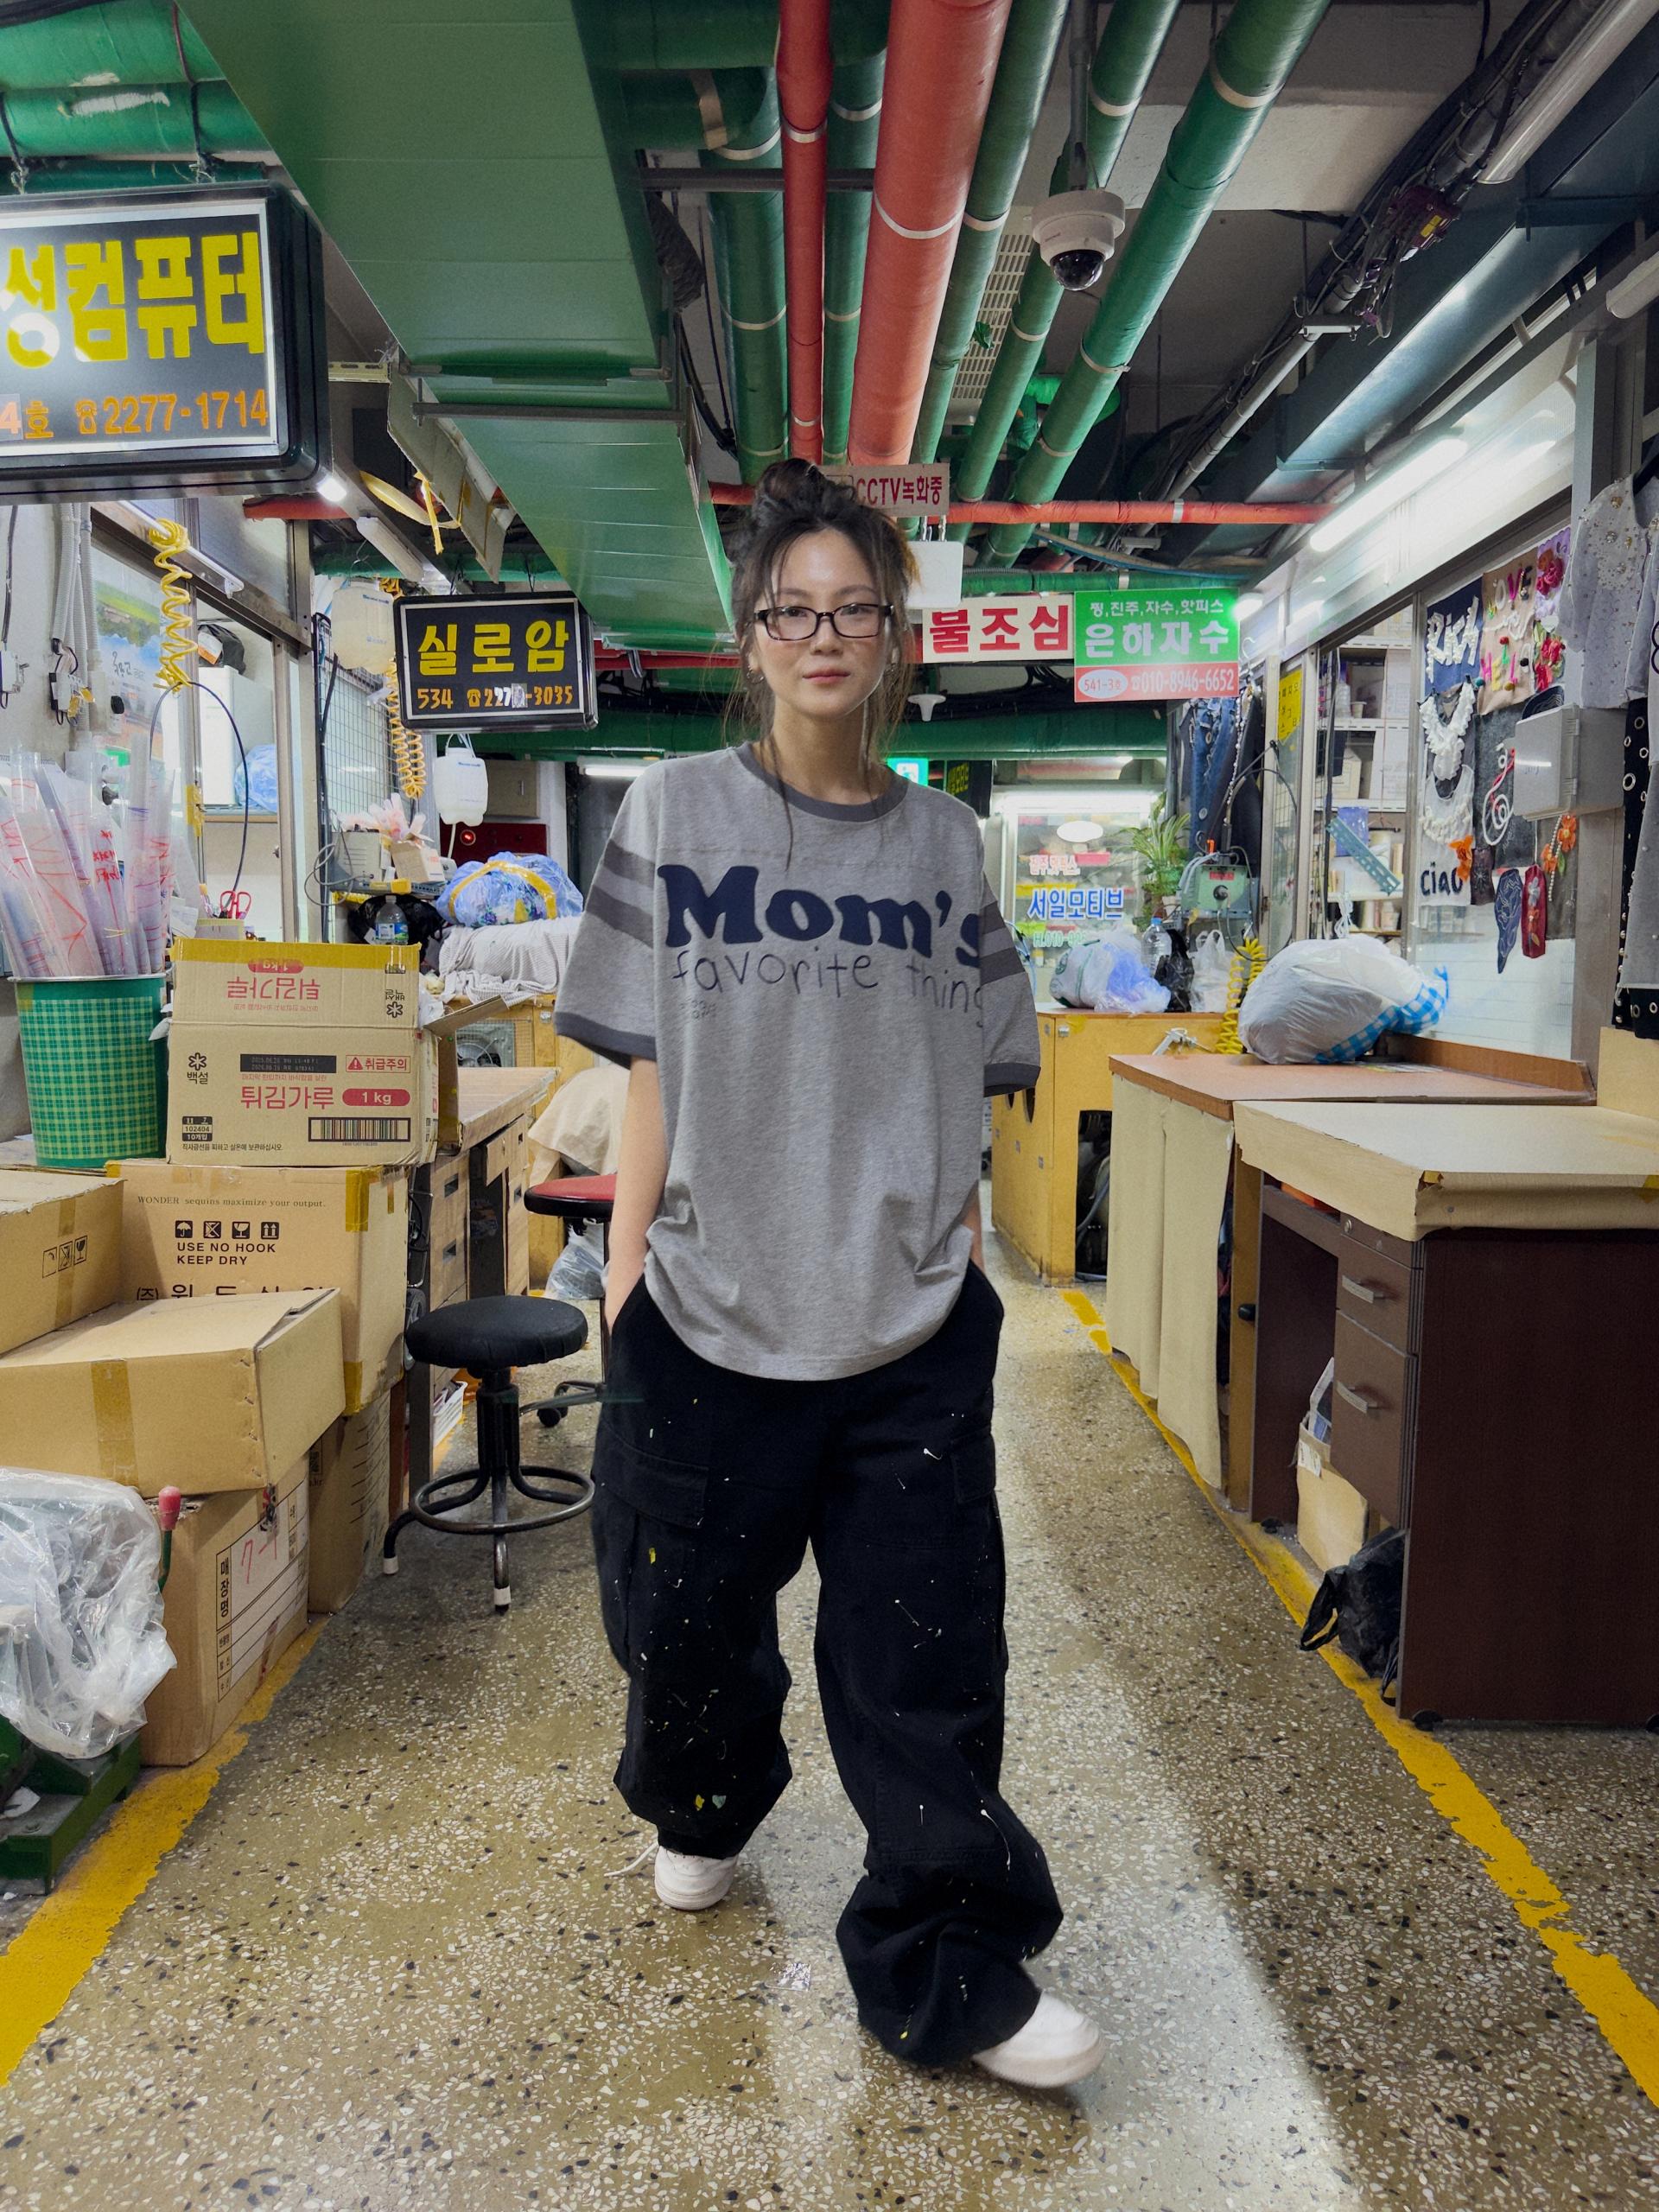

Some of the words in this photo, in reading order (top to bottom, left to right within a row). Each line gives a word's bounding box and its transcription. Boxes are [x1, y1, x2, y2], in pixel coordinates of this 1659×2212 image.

[103, 390, 269, 435] 2277-1714
[929, 605, 1069, 654] 불조심
[1084, 620, 1230, 658] 은하자수
[418, 620, 569, 676] 실로암
[1141, 668, 1235, 692] 010-8946-6652
[417, 689, 454, 709] 534
[1027, 888, 1123, 919] 서일모티브
[658, 864, 981, 969] Mom's
[671, 946, 879, 998] favorite
[227, 976, 321, 1000] 튀김가루
[385, 988, 405, 1001] 백설
[365, 1058, 407, 1071] 취급주의
[187, 1071, 208, 1084] 백설
[240, 1086, 334, 1109] 튀김가루
[361, 1091, 368, 1103] 1
[374, 1091, 392, 1105] kg
[137, 1196, 180, 1205] WONDER
[293, 1199, 327, 1208] output.
[177, 1242, 205, 1252] USE
[210, 1243, 230, 1252] NO
[235, 1243, 276, 1253] HOOK
[176, 1255, 213, 1264] KEEP
[219, 1255, 248, 1265] DRY
